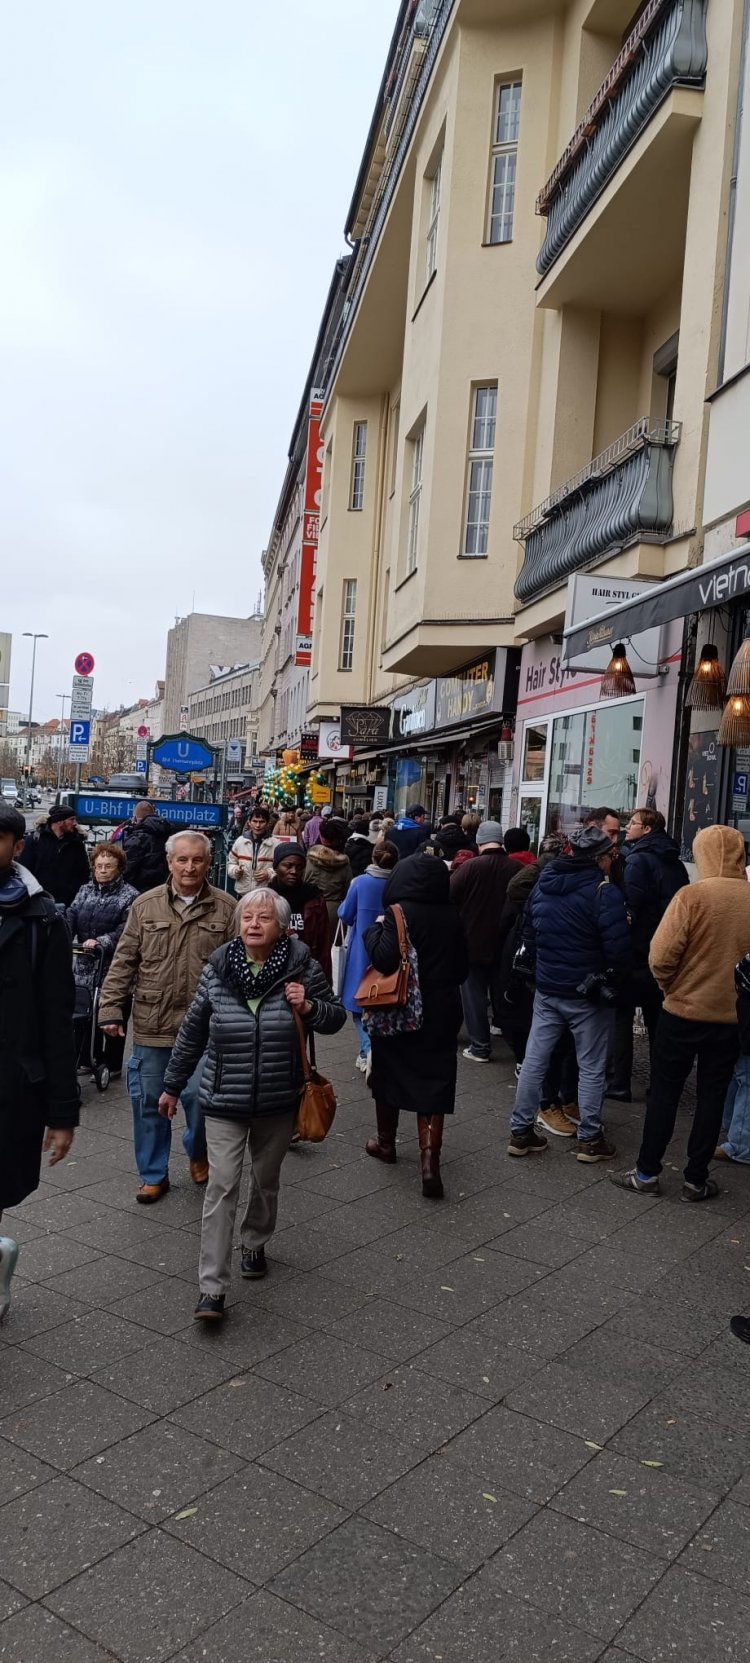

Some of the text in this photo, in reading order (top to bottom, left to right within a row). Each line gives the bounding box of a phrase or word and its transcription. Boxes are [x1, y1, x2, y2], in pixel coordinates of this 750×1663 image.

[592, 588, 611, 597] HAIR
[699, 564, 750, 605] vietn
[525, 661, 546, 692] Hair
[448, 689, 473, 718] HANDY
[72, 724, 84, 742] P
[178, 742, 189, 758] U
[137, 761, 144, 771] P
[85, 800, 216, 822] U-Bhf Hannplatz
